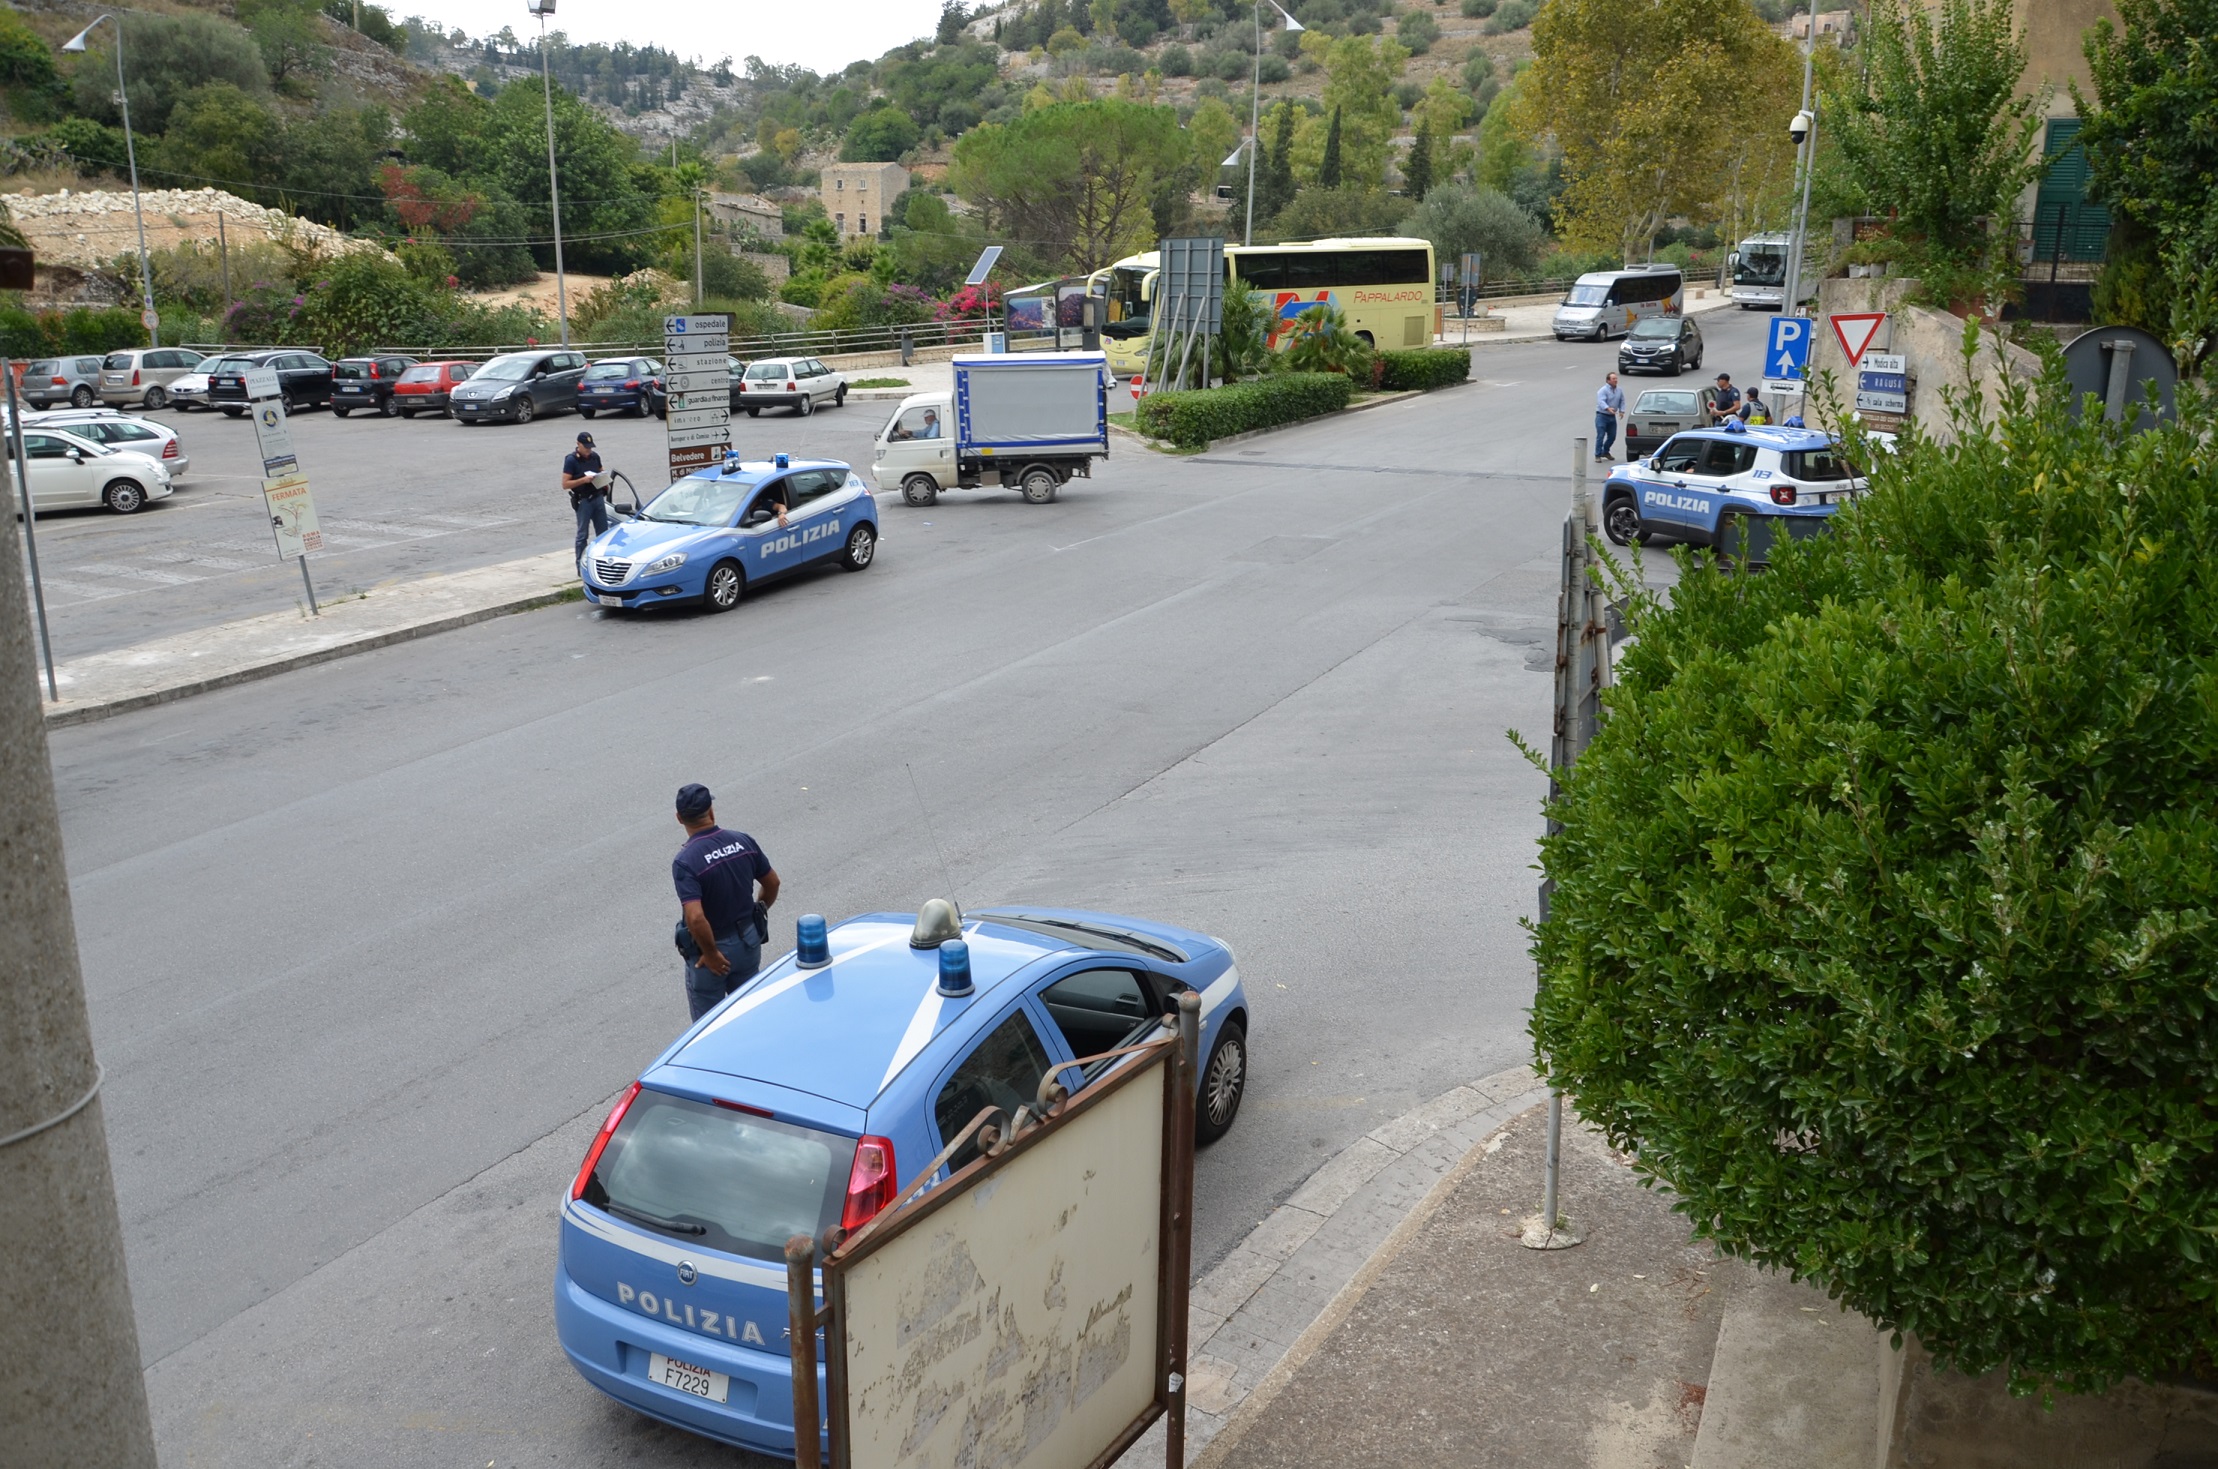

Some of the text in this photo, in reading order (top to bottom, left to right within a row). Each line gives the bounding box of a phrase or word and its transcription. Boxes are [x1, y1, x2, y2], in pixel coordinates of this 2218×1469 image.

[1353, 290, 1423, 304] PAPPALARDO
[695, 319, 726, 330] ospedale
[1775, 320, 1801, 351] P
[704, 338, 726, 348] polizia
[696, 358, 727, 366] stazione
[250, 375, 276, 385] PIAZZALE
[711, 377, 729, 385] centro
[1874, 377, 1902, 389] RAGUSA
[671, 452, 705, 463] Belvedere
[1752, 469, 1772, 479] 113
[272, 487, 307, 501] FERMATA
[1644, 490, 1710, 514] POLIZIA
[761, 519, 840, 559] POLIZIA
[704, 841, 745, 864] POLIZIA
[680, 1267, 694, 1280] FIAT
[616, 1281, 766, 1346] POLIZIA
[666, 1356, 711, 1378] POLIZIA
[664, 1368, 709, 1397] F7229
